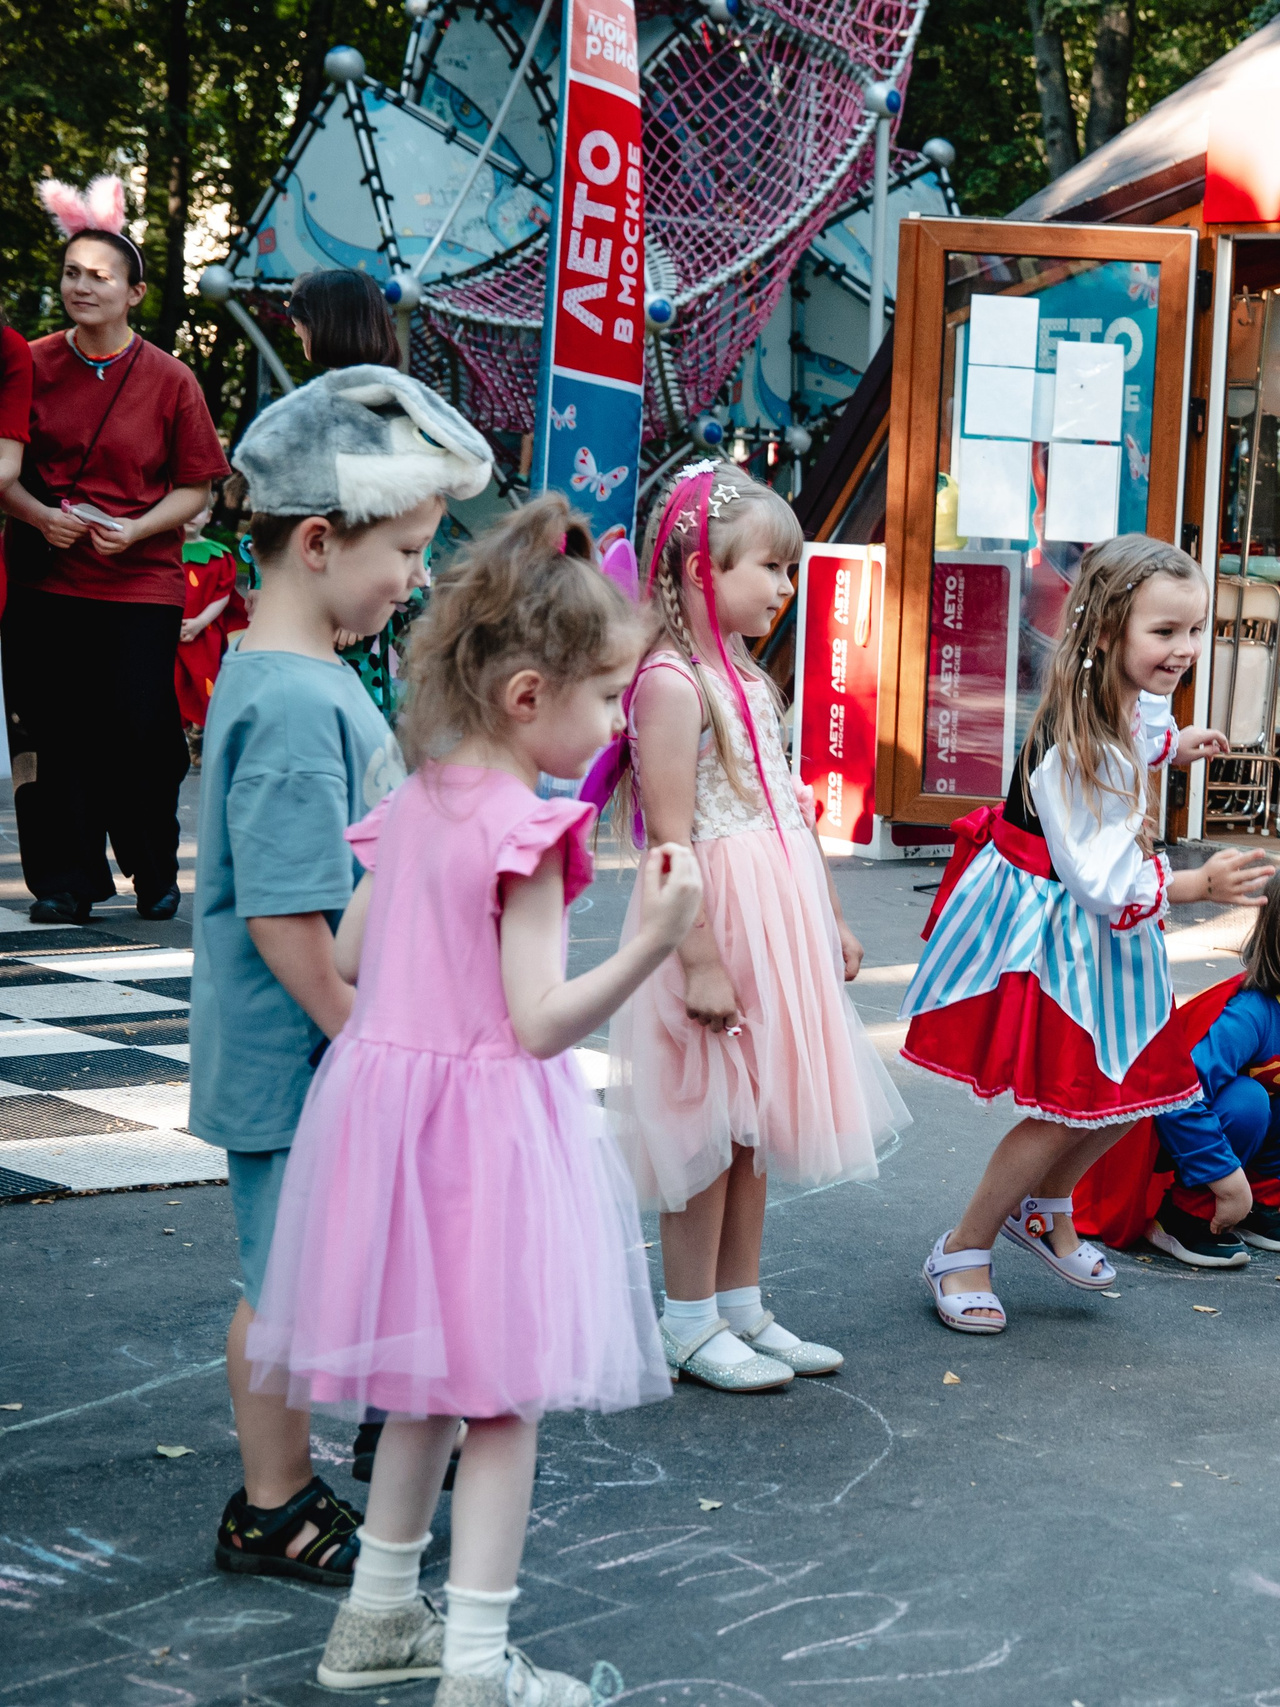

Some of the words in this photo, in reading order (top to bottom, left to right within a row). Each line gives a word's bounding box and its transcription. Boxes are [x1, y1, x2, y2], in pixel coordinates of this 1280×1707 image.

[562, 130, 621, 335] ЛЕТО
[617, 142, 641, 306] МОСКВЕ
[613, 317, 634, 344] В
[1038, 317, 1143, 372] ЕТО
[834, 569, 845, 625] ЛЕТО
[943, 575, 957, 629] ЛЕТО
[831, 638, 842, 693] ЛЕТО
[940, 644, 953, 698] ЛЕТО
[829, 703, 839, 758] ЛЕТО
[937, 709, 950, 763] ЛЕТО
[827, 771, 838, 826] ЛЕТО
